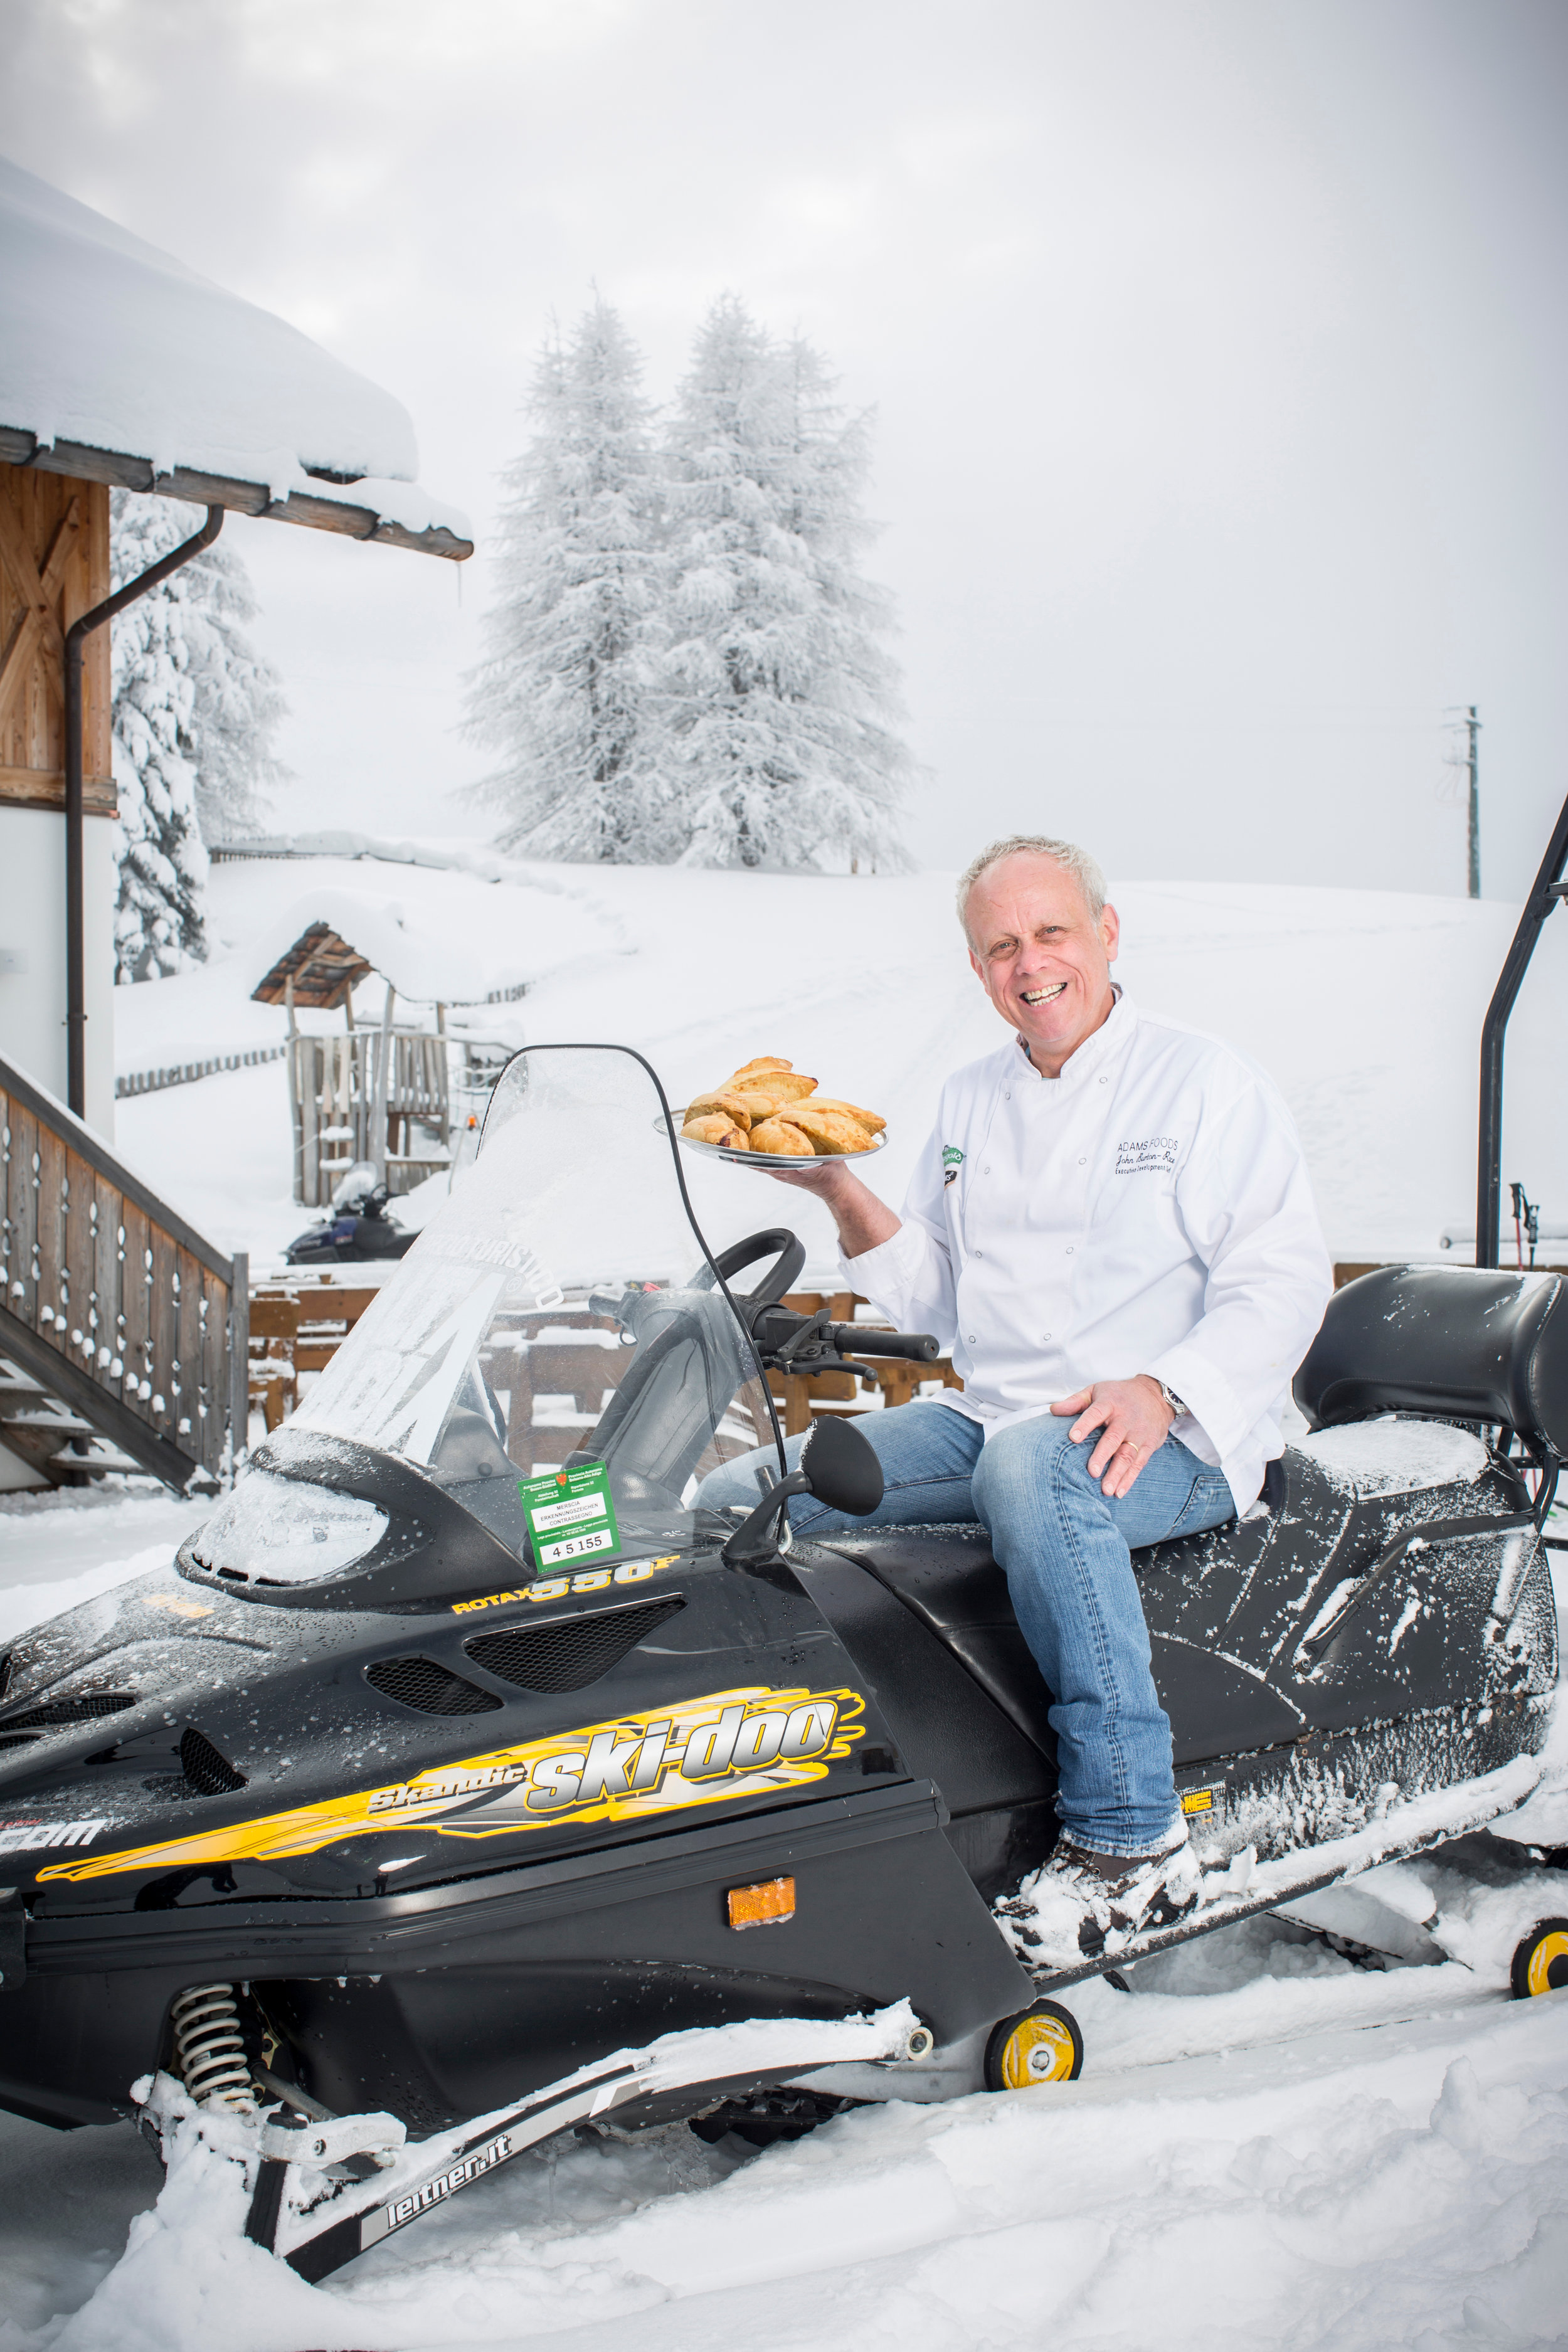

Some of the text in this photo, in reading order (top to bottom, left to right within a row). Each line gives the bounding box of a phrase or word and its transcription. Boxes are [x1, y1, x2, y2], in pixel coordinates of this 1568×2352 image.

[1118, 1137, 1179, 1152] ADAMS FOODS
[1116, 1154, 1134, 1167] John
[541, 1503, 598, 1521] ERKENNUNGSZEICHEN
[557, 1502, 580, 1510] MERSCIA
[549, 1511, 593, 1526] CONTRASSEGNO
[578, 1535, 602, 1551] 155
[451, 1587, 534, 1615] ROTAX
[368, 1766, 526, 1813] Skandic
[387, 2135, 512, 2229] leitner.it
